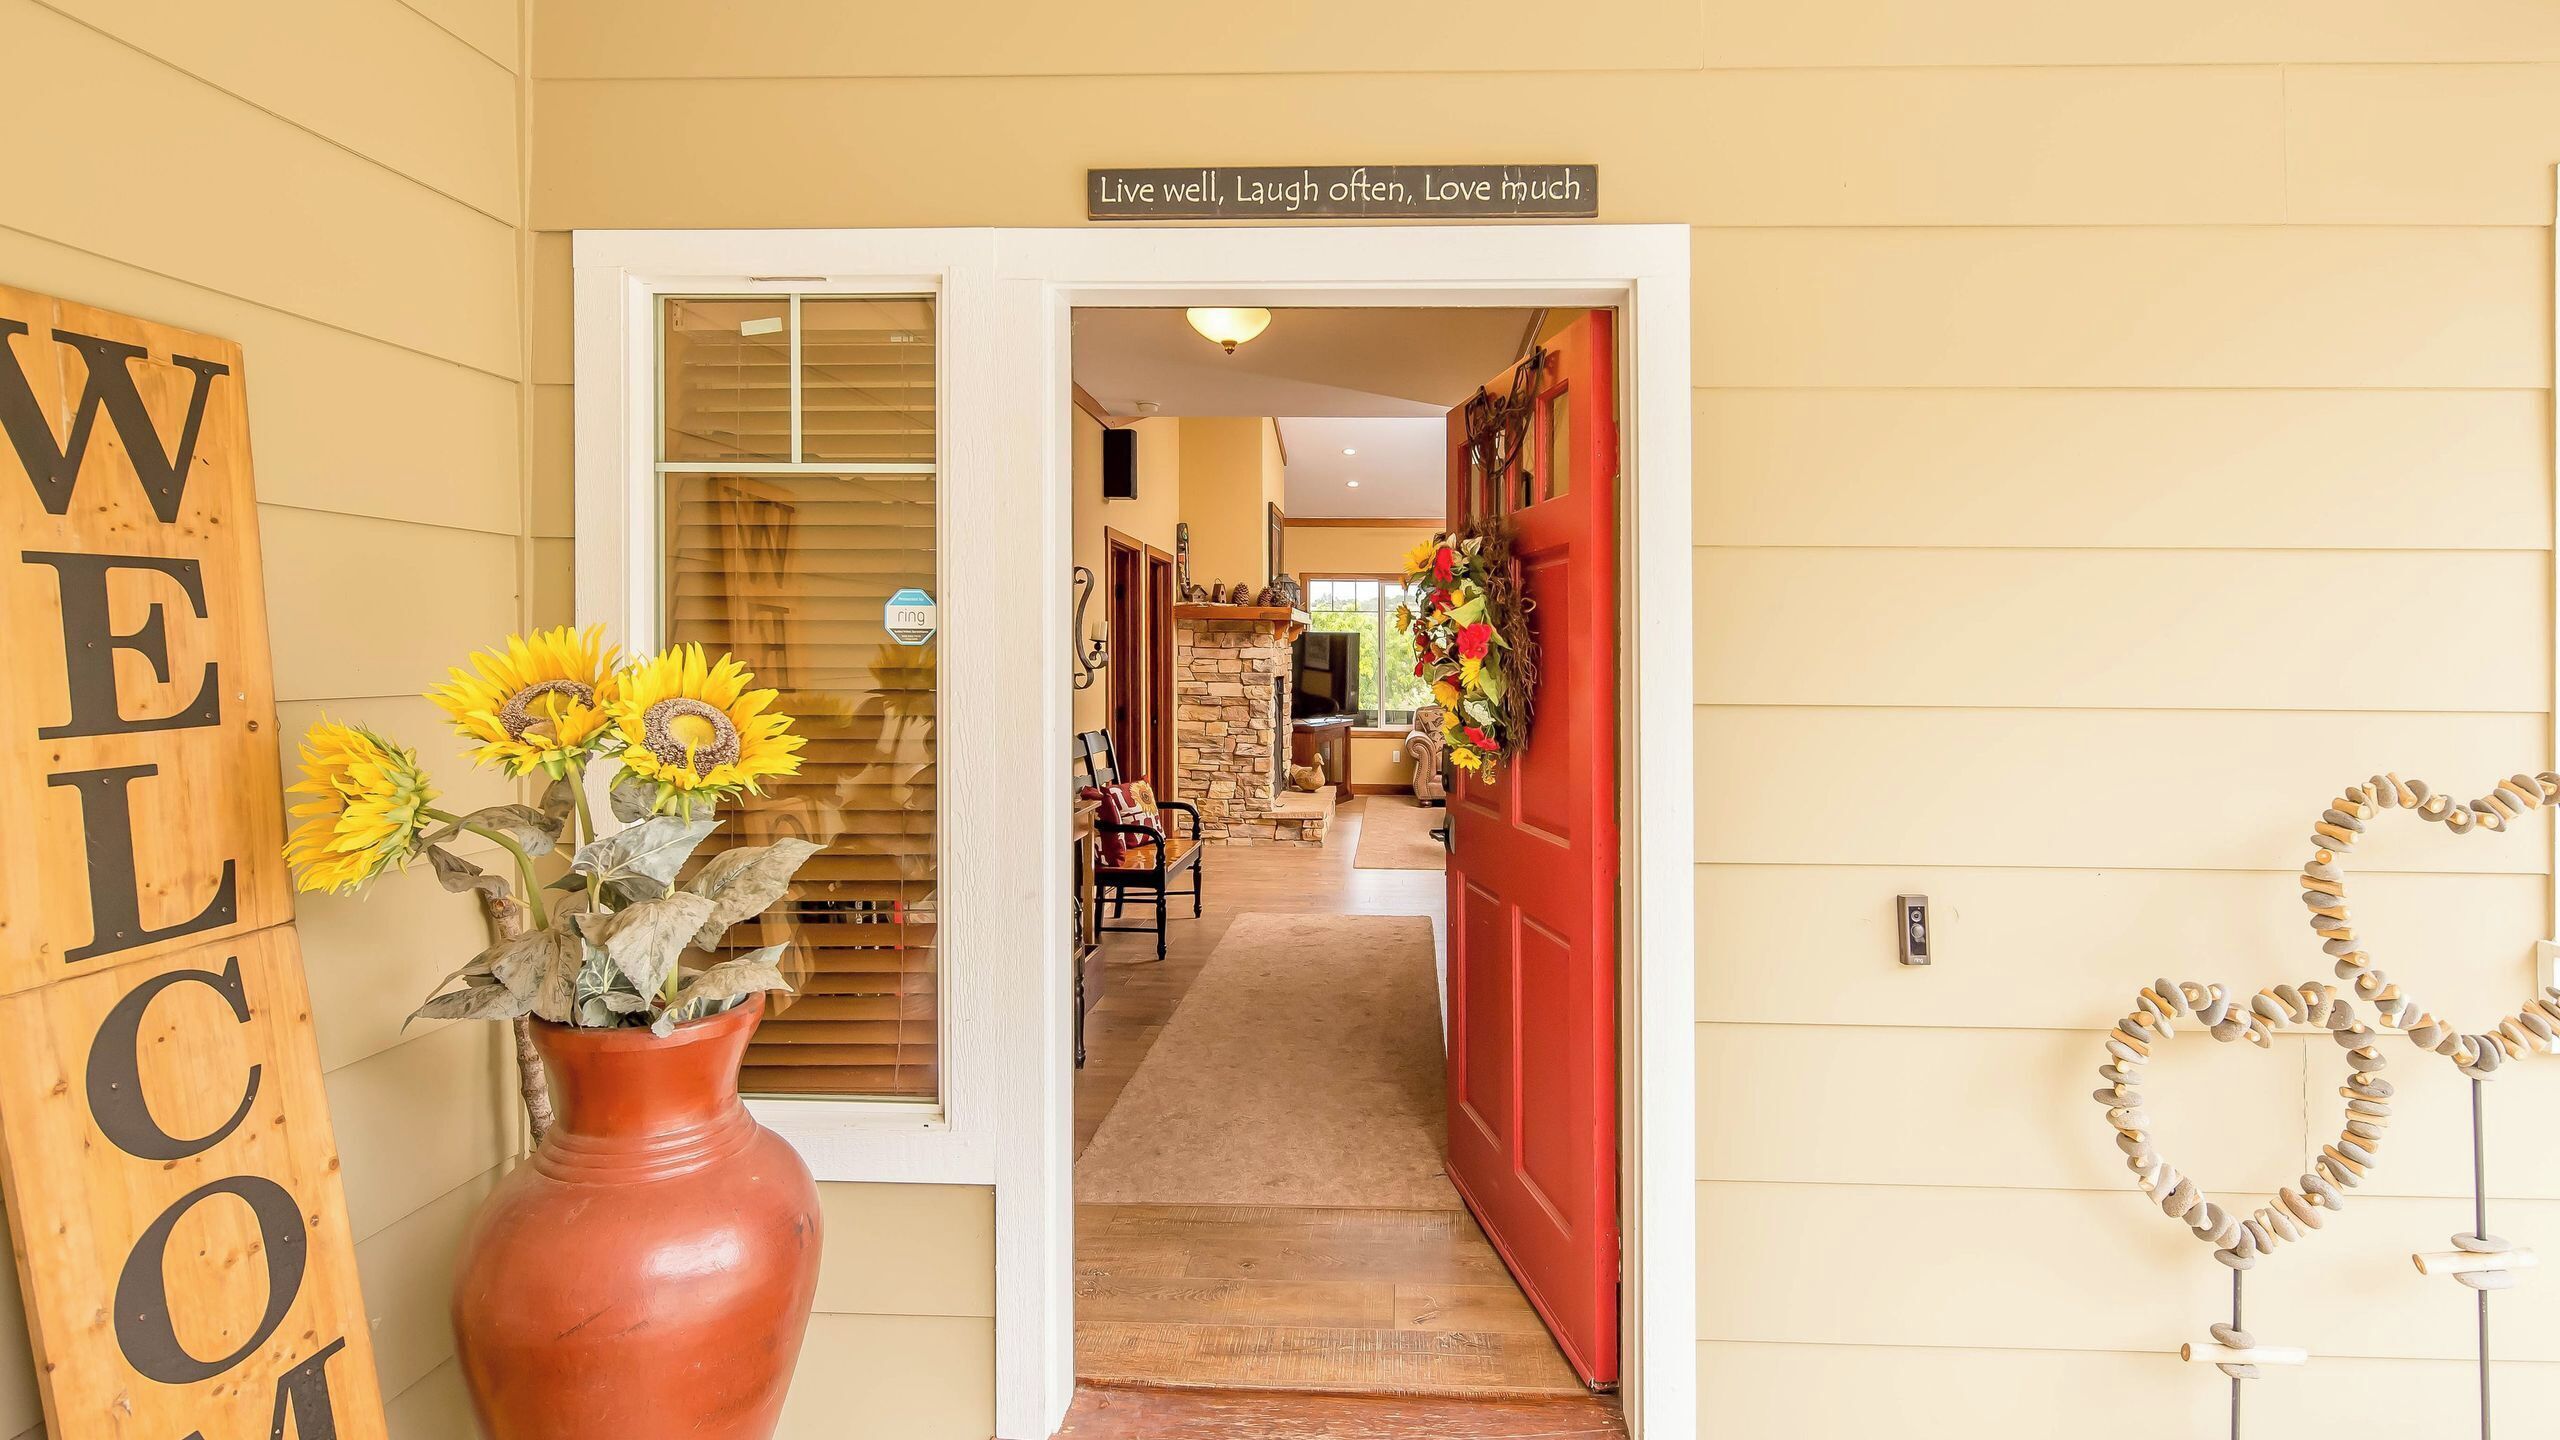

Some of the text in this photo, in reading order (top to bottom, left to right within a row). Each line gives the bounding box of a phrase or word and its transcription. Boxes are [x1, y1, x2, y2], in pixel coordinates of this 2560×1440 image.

[1101, 168, 1581, 211] Live well, Laugh often, Love much
[897, 608, 925, 626] ring
